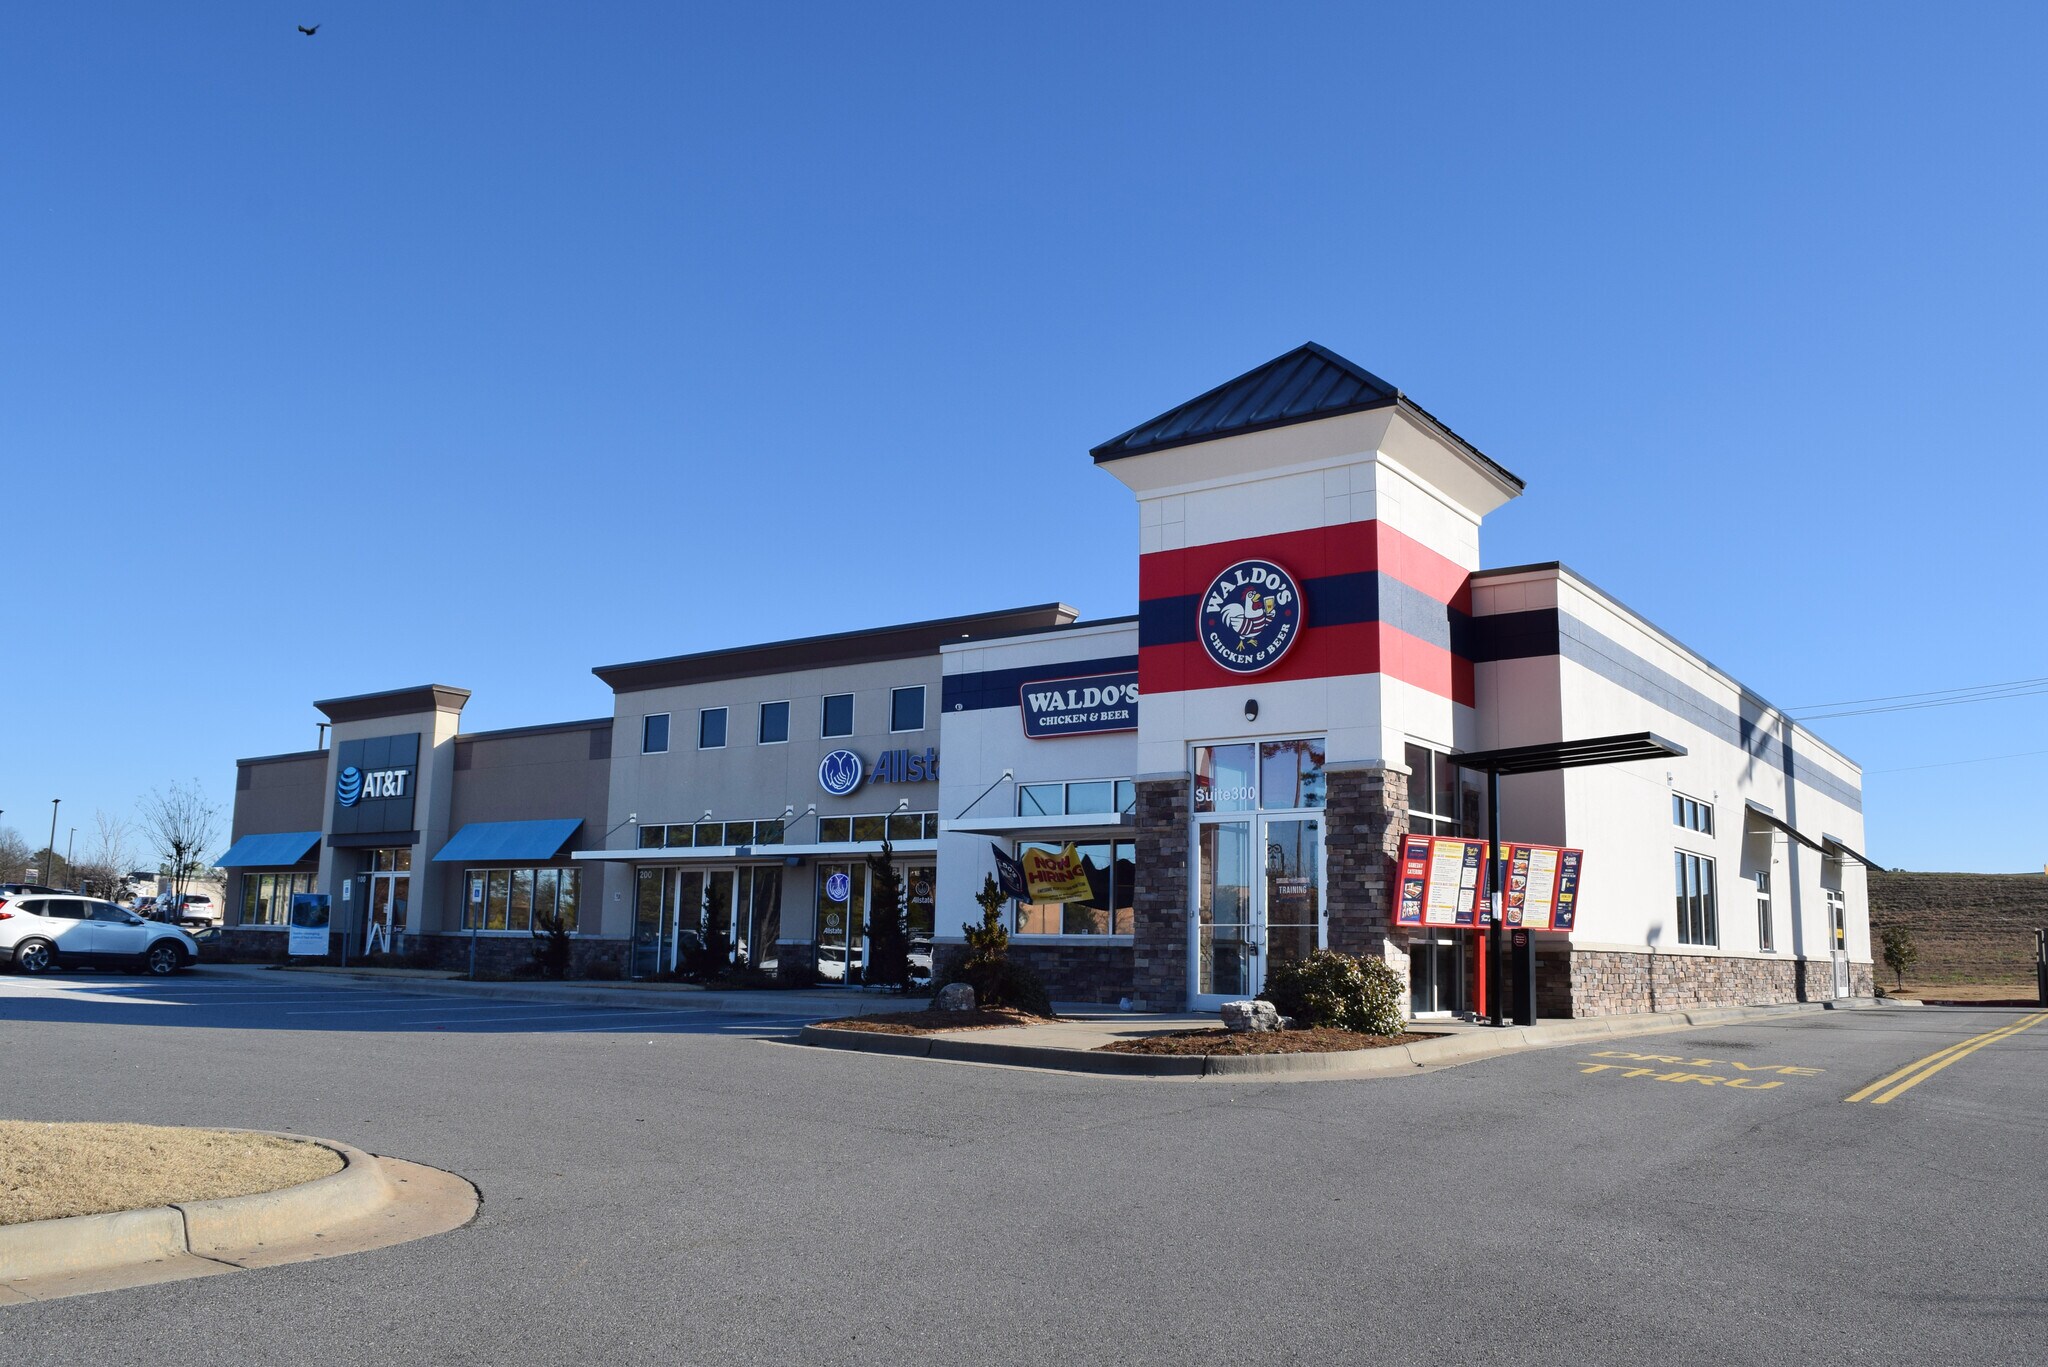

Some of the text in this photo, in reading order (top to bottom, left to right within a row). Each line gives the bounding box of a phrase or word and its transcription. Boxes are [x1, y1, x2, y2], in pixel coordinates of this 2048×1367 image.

[1206, 567, 1292, 613] WALDO'S
[1209, 623, 1291, 664] CHICKEN & BEER
[1028, 683, 1139, 713] WALDO'S
[1039, 709, 1129, 726] CHICKEN & BEER
[868, 747, 940, 785] Allst
[361, 769, 410, 799] AT&T
[1028, 864, 1085, 884] HIRING
[1034, 855, 1070, 870] NOW
[639, 870, 653, 879] 200
[911, 896, 934, 904] Allstate
[1279, 885, 1307, 894] TRAINING
[823, 926, 843, 935] Allstate
[1577, 1062, 1785, 1089] THRU
[1590, 1051, 1826, 1077] DRIVE
